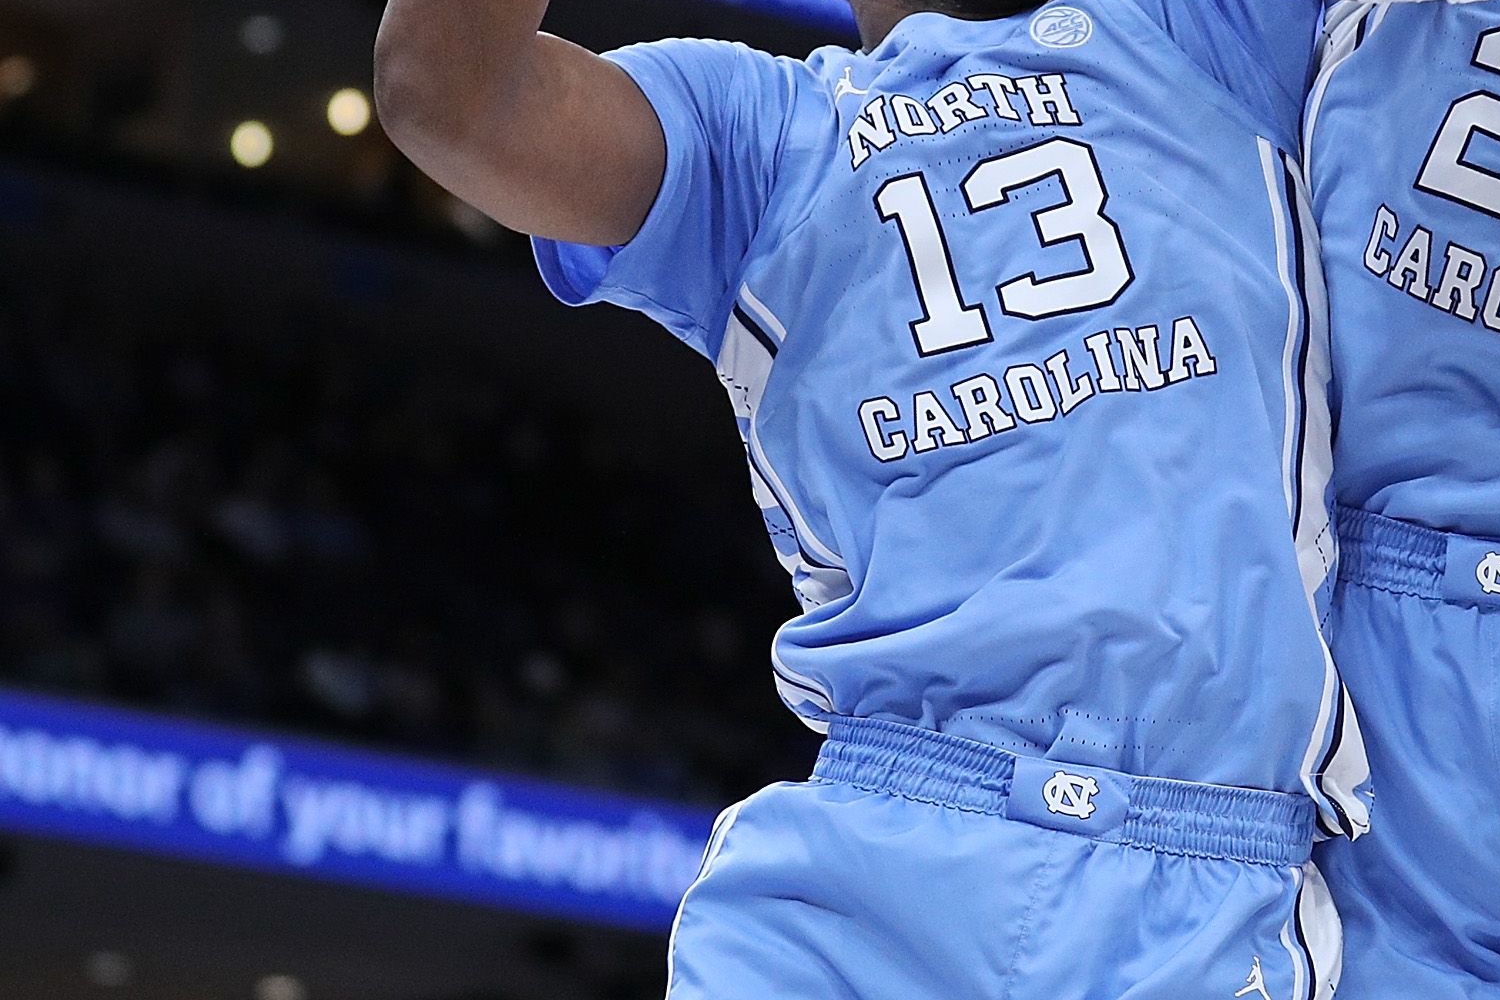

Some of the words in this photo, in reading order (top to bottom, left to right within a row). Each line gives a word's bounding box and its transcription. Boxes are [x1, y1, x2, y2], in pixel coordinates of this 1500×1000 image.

[847, 73, 1082, 170] NORTH
[873, 136, 1135, 358] 13
[857, 316, 1217, 463] CAROLINA
[0, 726, 185, 820] onor
[190, 744, 282, 836] of
[281, 774, 450, 864] your
